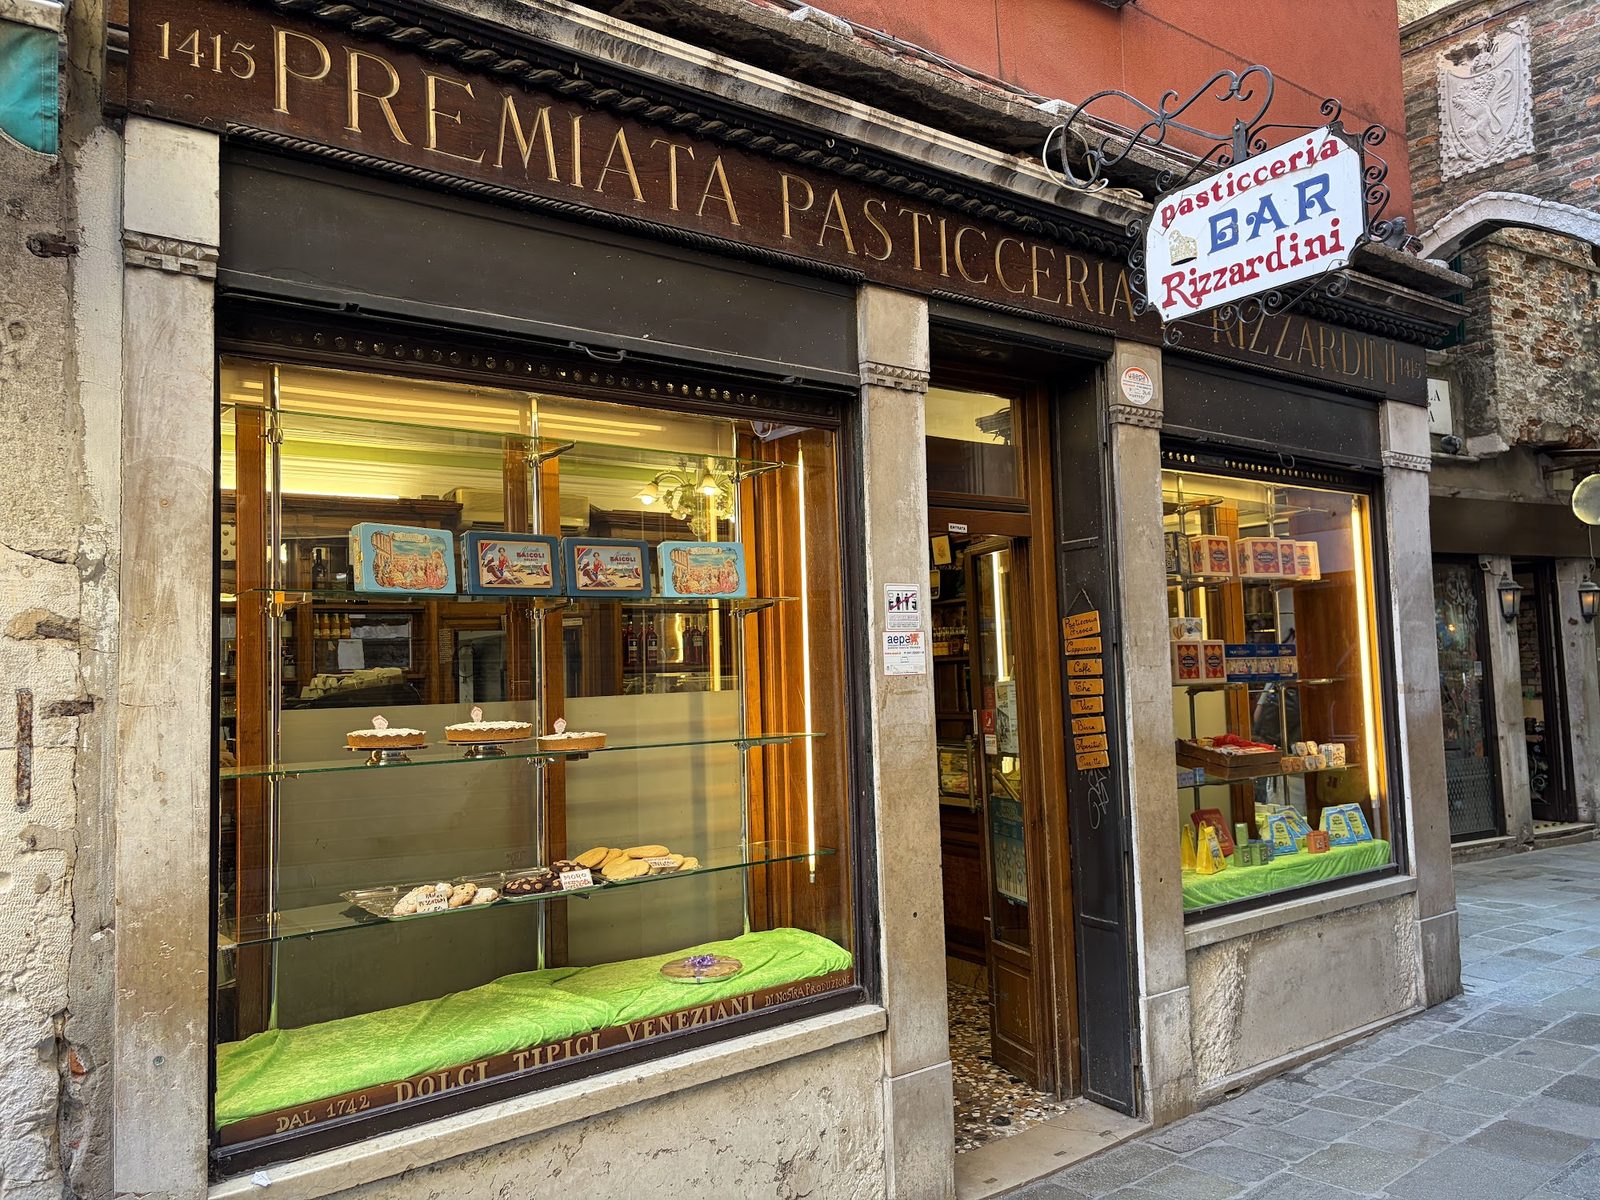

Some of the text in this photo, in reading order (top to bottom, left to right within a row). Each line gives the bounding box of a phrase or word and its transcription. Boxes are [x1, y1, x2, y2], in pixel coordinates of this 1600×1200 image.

[157, 22, 257, 80] 1415
[273, 24, 741, 227] PREMIATA
[778, 171, 1136, 323] PASTICCERIA
[1400, 357, 1422, 380] 1415
[1160, 137, 1340, 230] pasticceria
[1207, 172, 1337, 256] BAR
[1161, 217, 1345, 310] Rizzardini
[276, 1109, 316, 1133] DAL
[327, 1094, 370, 1118] 1742
[393, 1061, 489, 1103] DOLCI
[513, 1033, 602, 1072] TIPICI
[622, 993, 756, 1042] VENEZIANI
